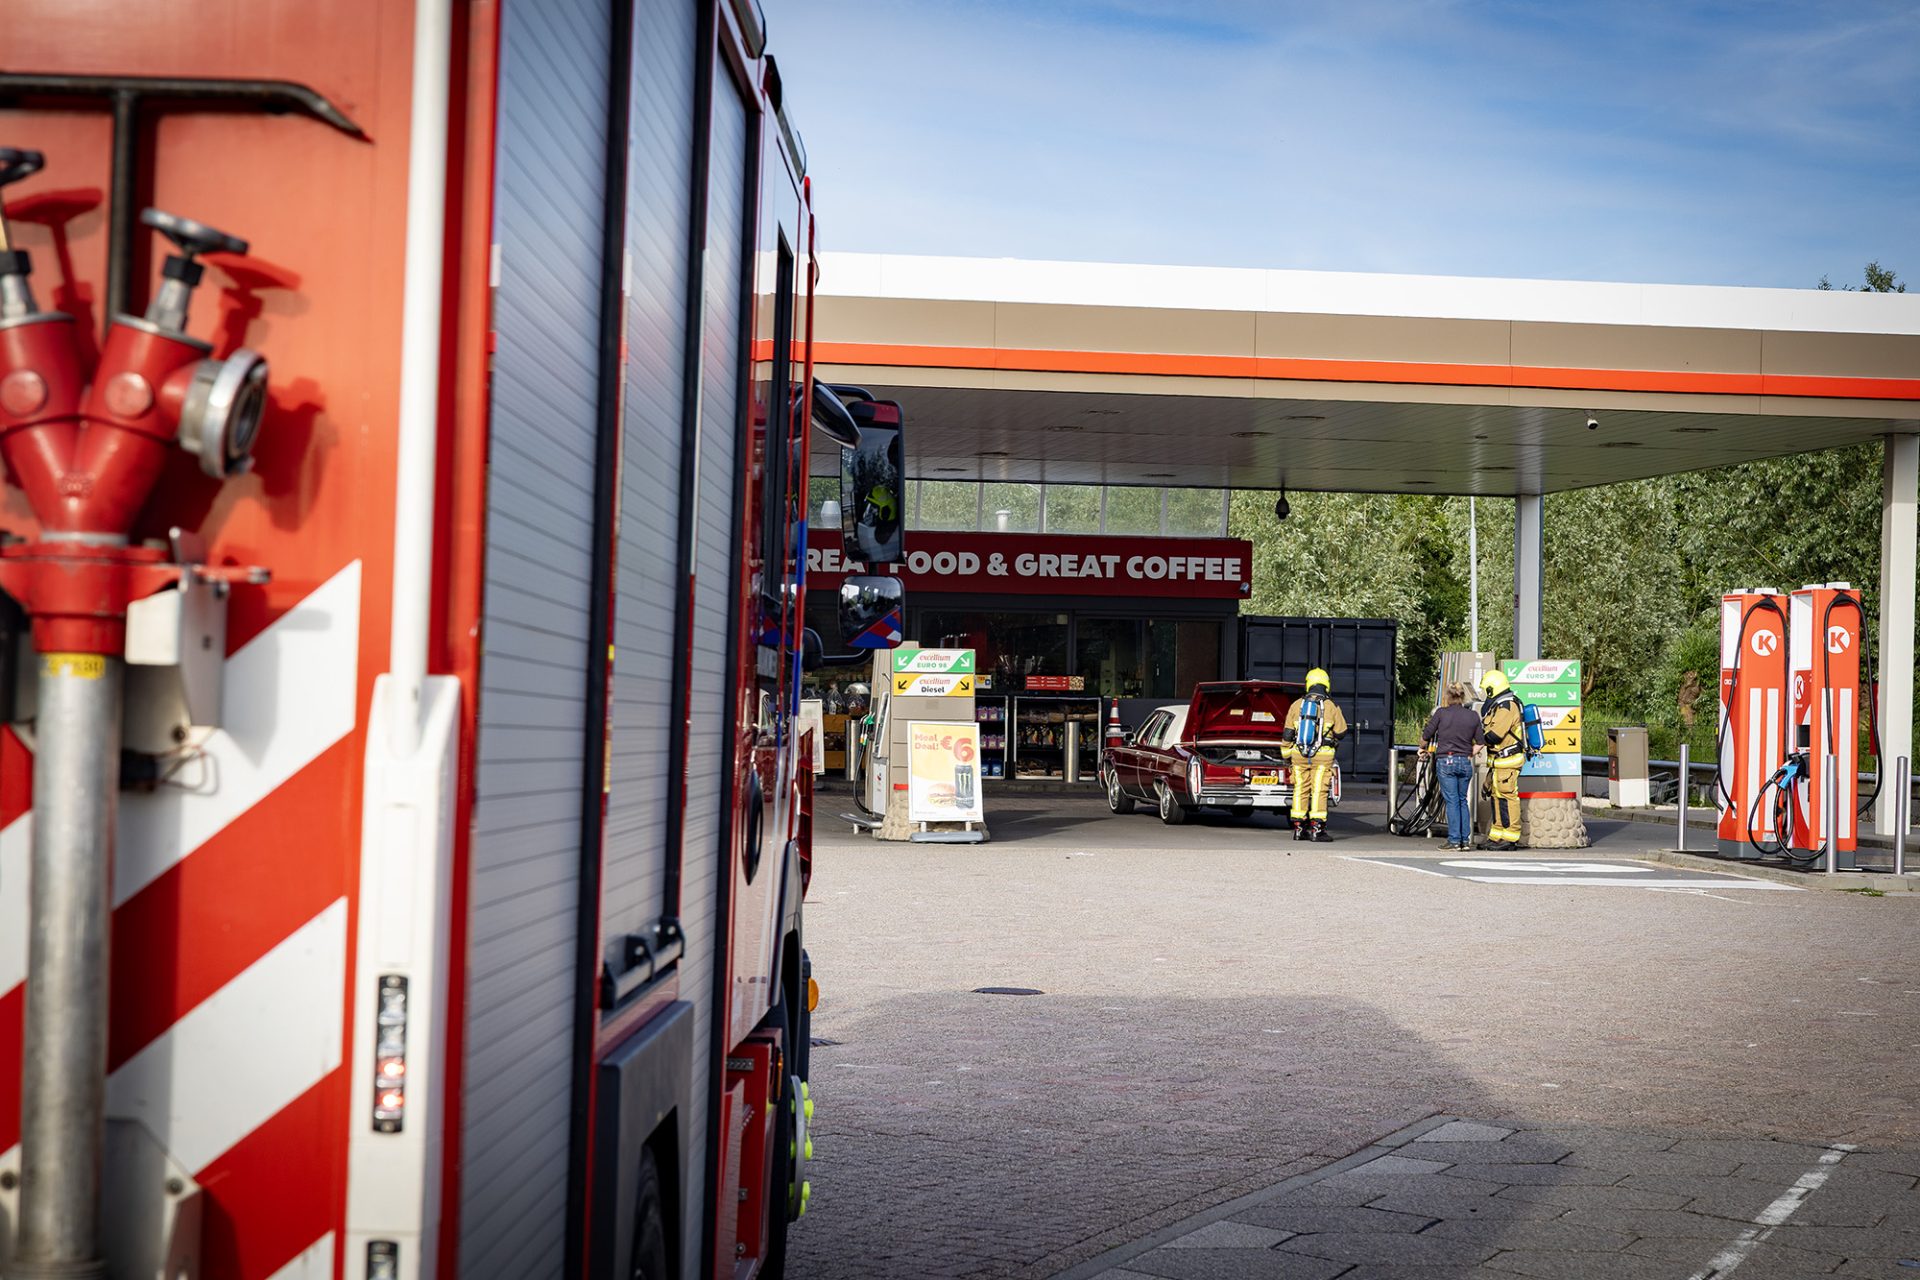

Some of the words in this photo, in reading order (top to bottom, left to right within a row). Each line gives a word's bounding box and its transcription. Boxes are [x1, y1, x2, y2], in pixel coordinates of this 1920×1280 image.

[806, 548, 866, 573] REA
[986, 552, 1009, 576] &
[1014, 553, 1121, 578] GREAT
[1126, 556, 1242, 581] COFFEE
[915, 733, 938, 742] Meal
[914, 742, 939, 751] Deal!
[1534, 761, 1552, 769] LPG
